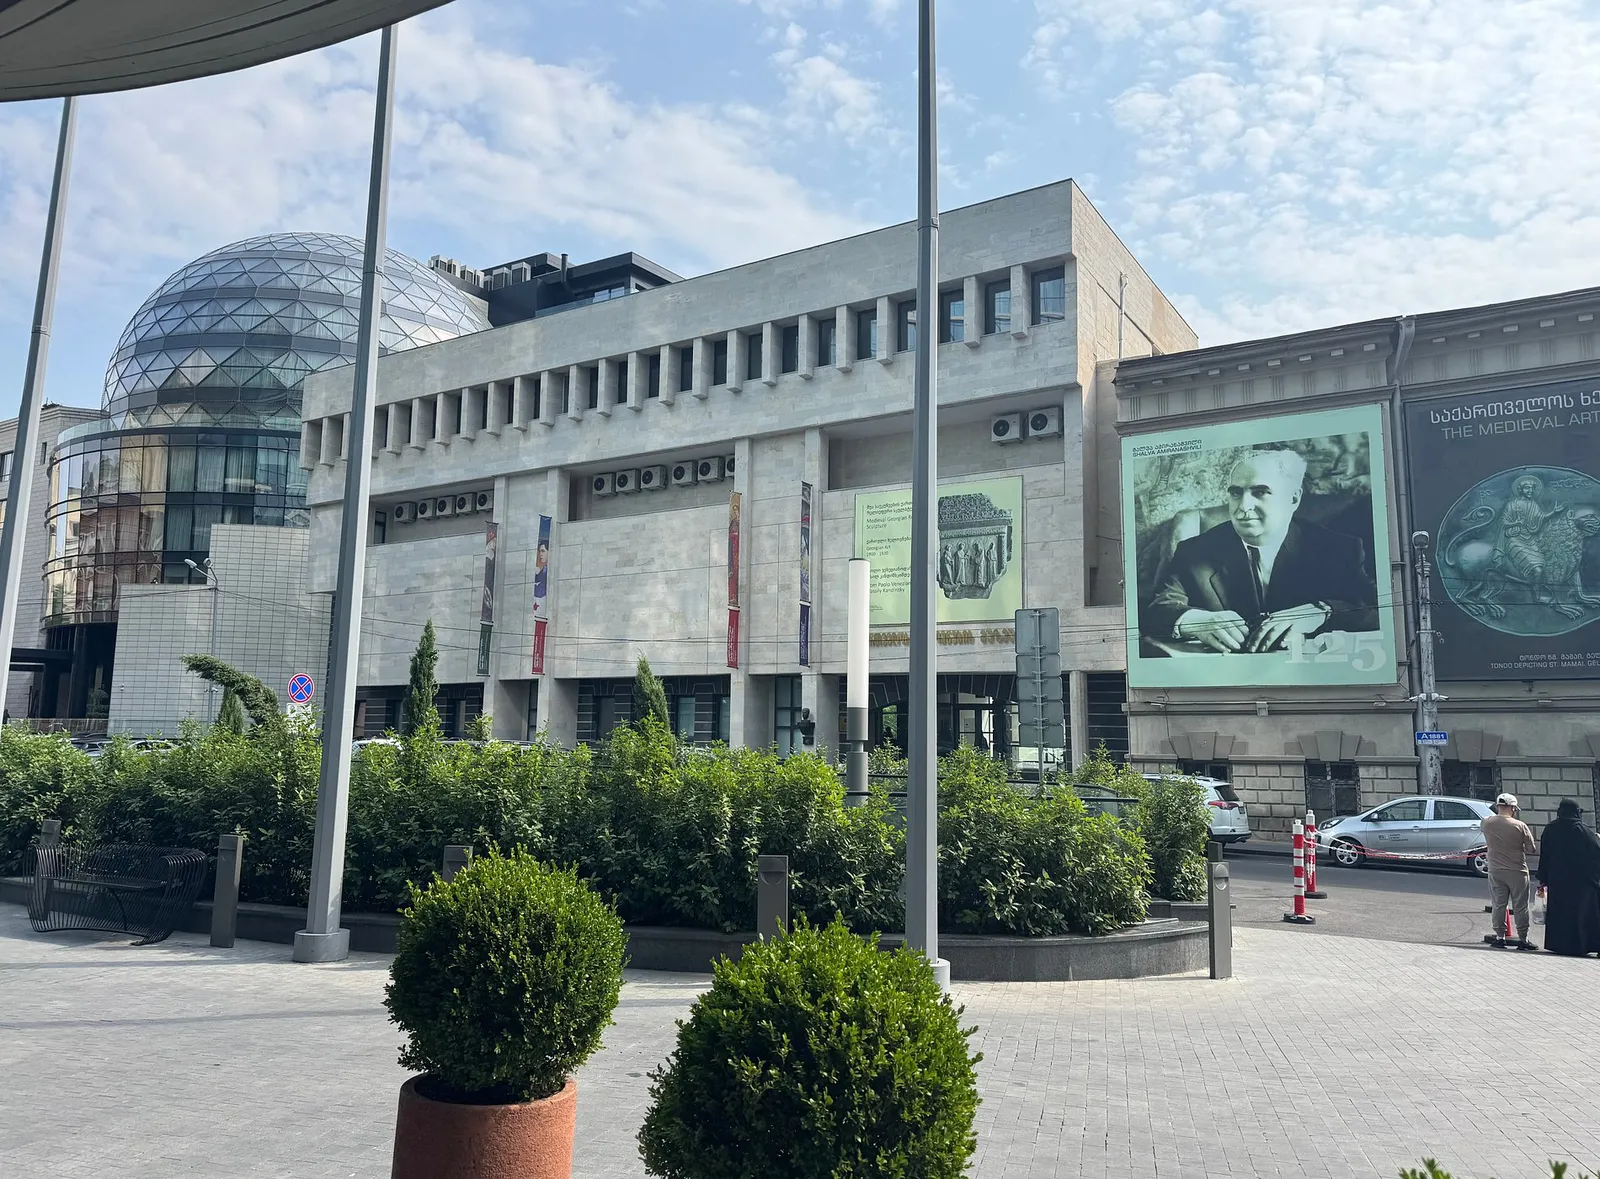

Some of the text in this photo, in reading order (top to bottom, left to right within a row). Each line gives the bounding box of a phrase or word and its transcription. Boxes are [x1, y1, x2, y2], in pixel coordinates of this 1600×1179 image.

[1430, 394, 1574, 424] საქართველოს
[1441, 425, 1473, 440] THE
[1479, 415, 1564, 436] MEDIEVAL
[1132, 444, 1202, 458] SHALVA AMIRANASHVILI
[1281, 630, 1387, 672] 125
